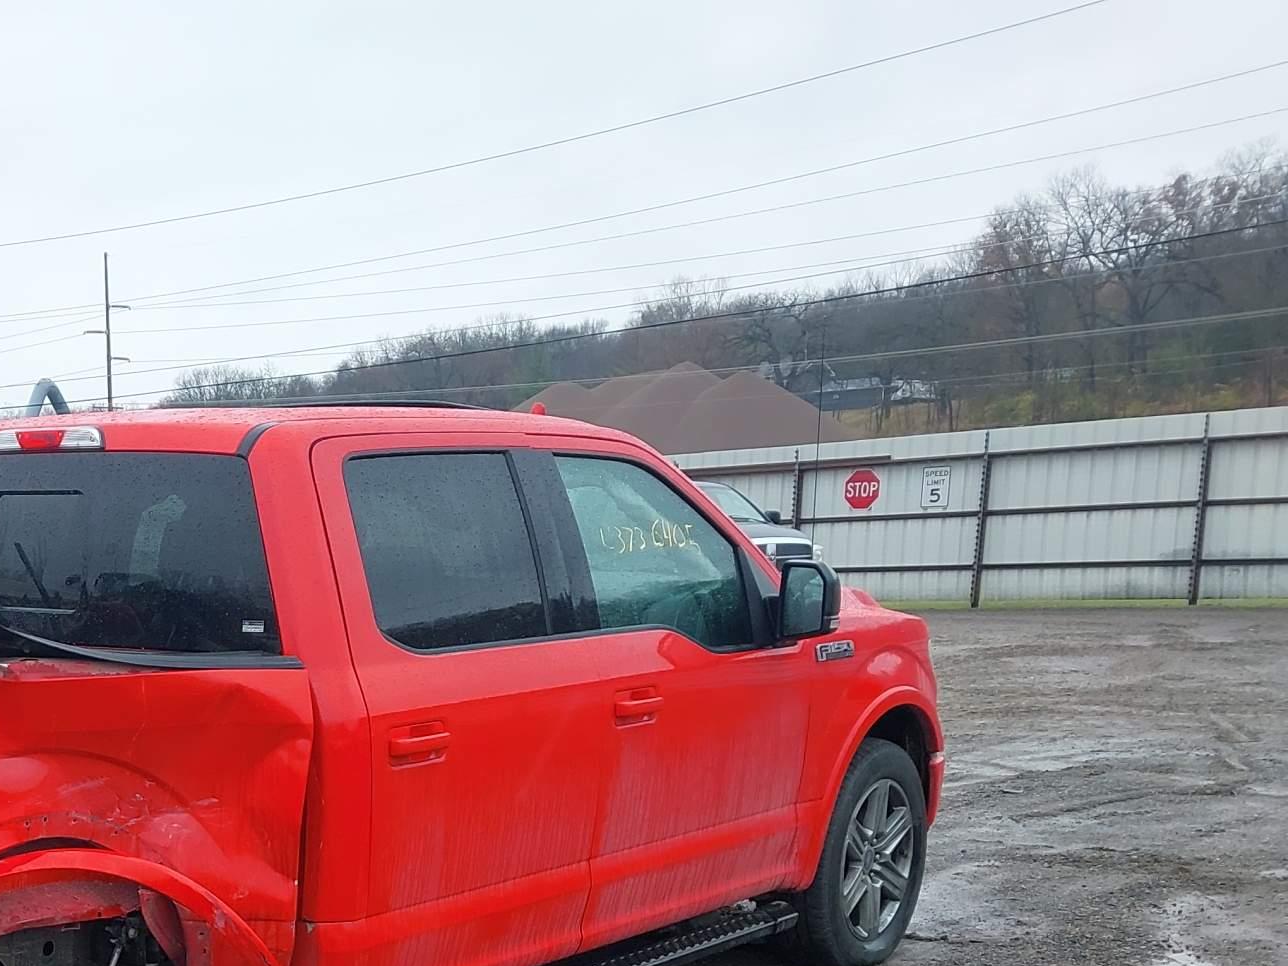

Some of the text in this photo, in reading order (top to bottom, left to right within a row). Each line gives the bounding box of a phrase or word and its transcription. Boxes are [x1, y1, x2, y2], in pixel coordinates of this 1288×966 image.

[846, 482, 878, 497] STOP
[926, 478, 946, 486] LIMIT
[929, 488, 941, 503] 5
